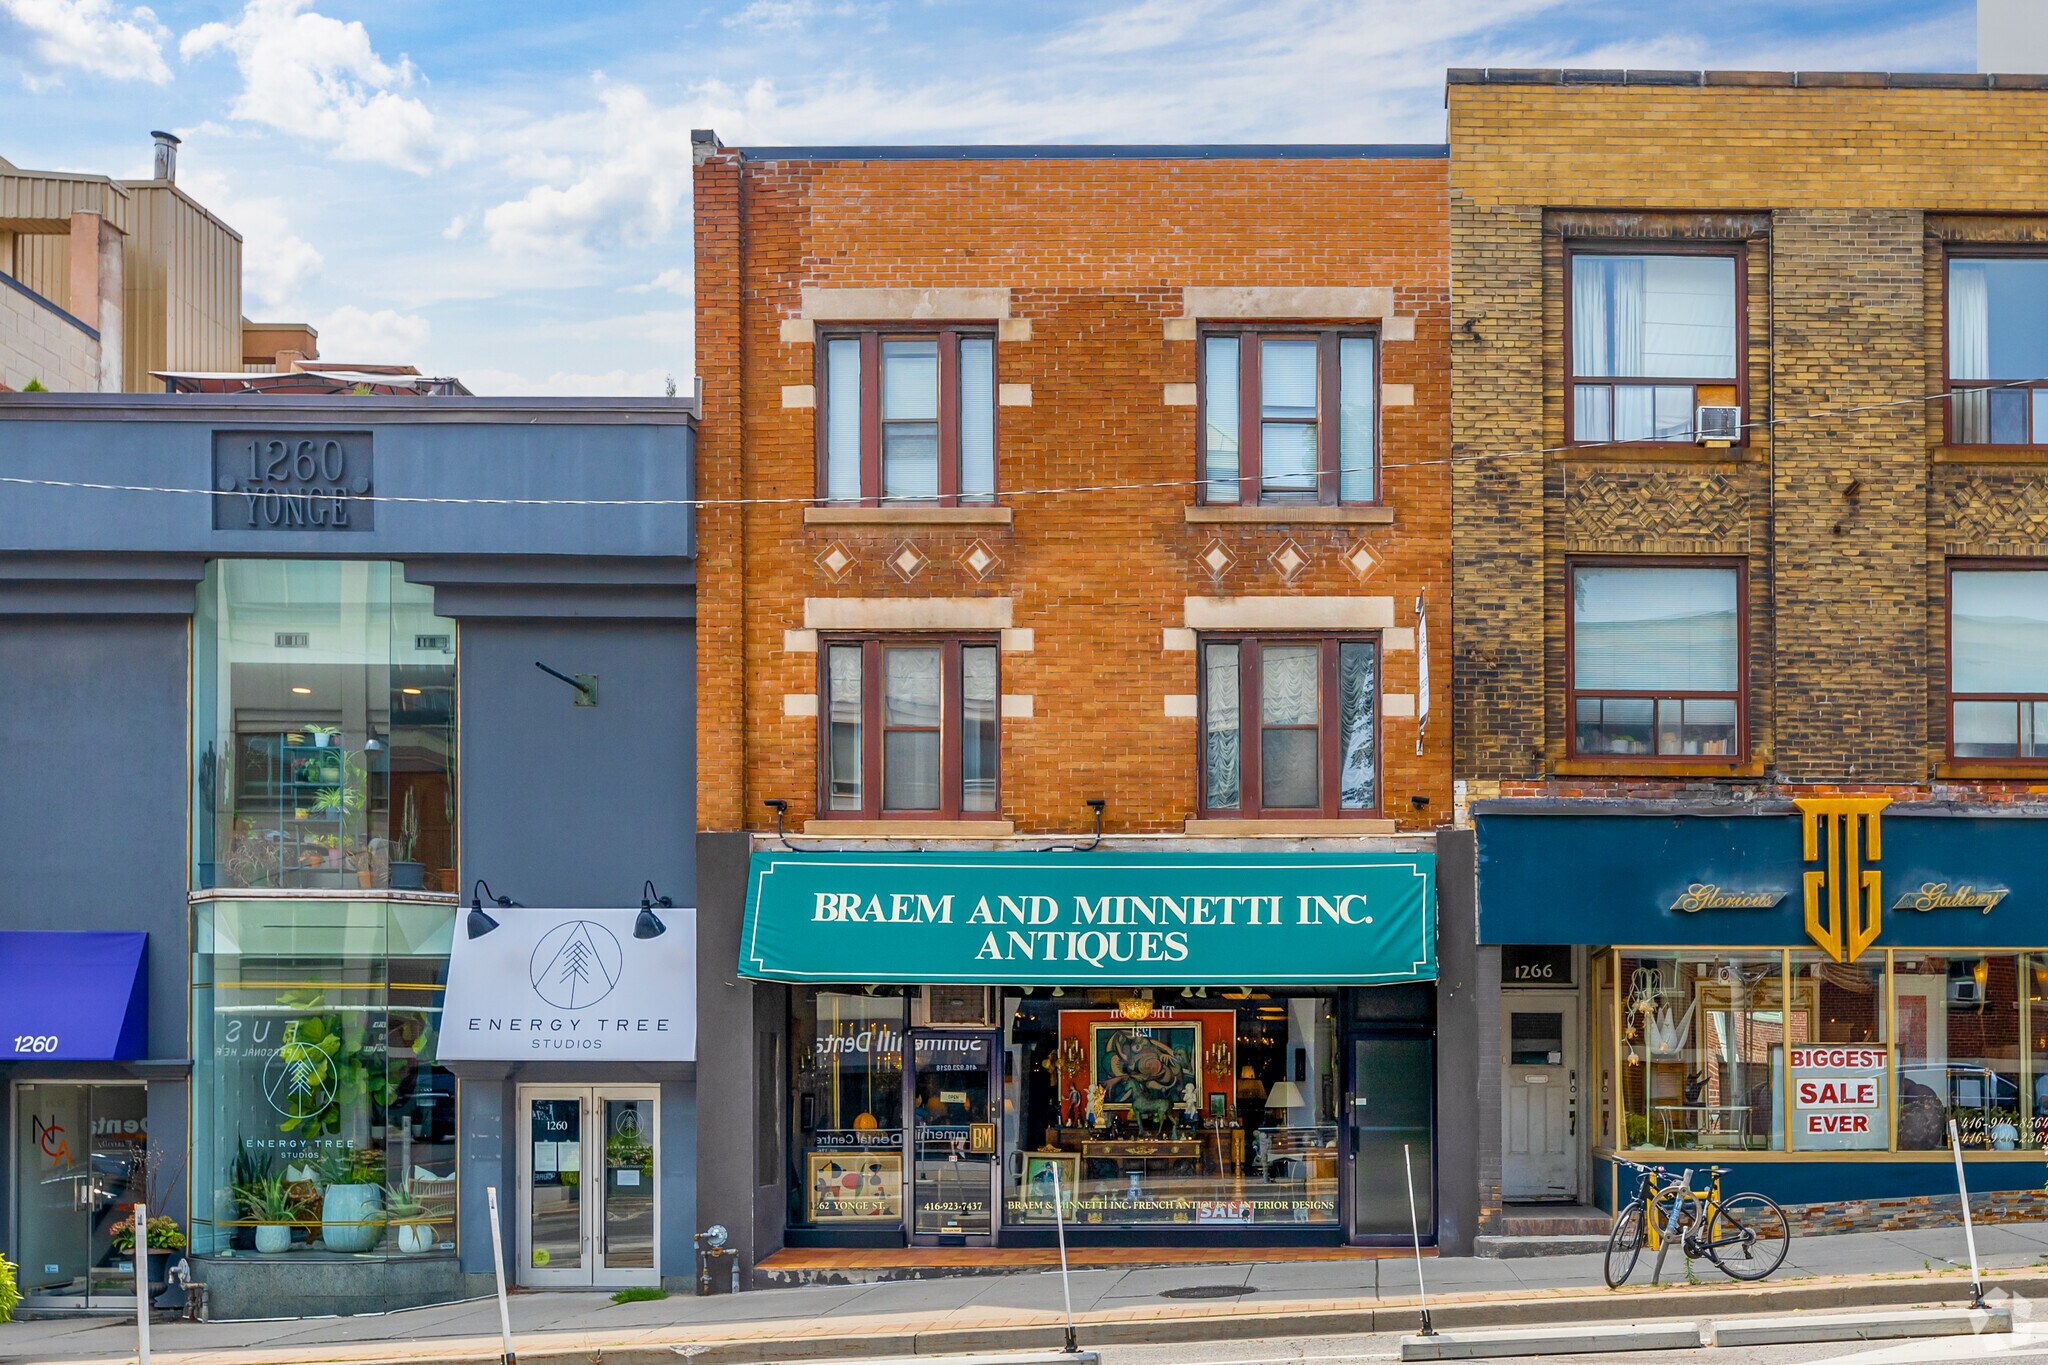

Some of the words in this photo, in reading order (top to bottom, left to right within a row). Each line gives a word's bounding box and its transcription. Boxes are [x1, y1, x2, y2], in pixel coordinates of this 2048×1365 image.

[248, 439, 343, 481] 1260
[242, 487, 349, 526] YONGE
[1682, 883, 1773, 912] Glorious
[1915, 882, 1999, 914] Gallery
[811, 892, 955, 924] BRAEM
[966, 895, 1059, 925] AND
[1072, 895, 1283, 925] MINNETTI
[1296, 894, 1373, 925] INC.
[975, 930, 1188, 968] ANTIQUES
[1515, 964, 1553, 979] 1266
[468, 1018, 581, 1031] ENERGY
[598, 1018, 669, 1031] TREE
[14, 1035, 58, 1053] 1260
[531, 1038, 602, 1049] STUDIOS
[1791, 1049, 1887, 1067] BIGGEST
[1800, 1083, 1874, 1104] SALE
[546, 1120, 568, 1131] 1260
[1809, 1115, 1868, 1132] EVER
[246, 1139, 308, 1148] ENERGY
[315, 1139, 354, 1148] TREE
[973, 1128, 992, 1149] BM
[834, 1202, 869, 1210] YONGE
[872, 1202, 885, 1210] ST.
[924, 1201, 982, 1212] 416-923-7437
[1007, 1201, 1043, 1210] BRAEM
[1045, 1202, 1054, 1210] &
[1133, 1201, 1173, 1210] FRENCH
[1291, 1201, 1335, 1210] DESIGNS
